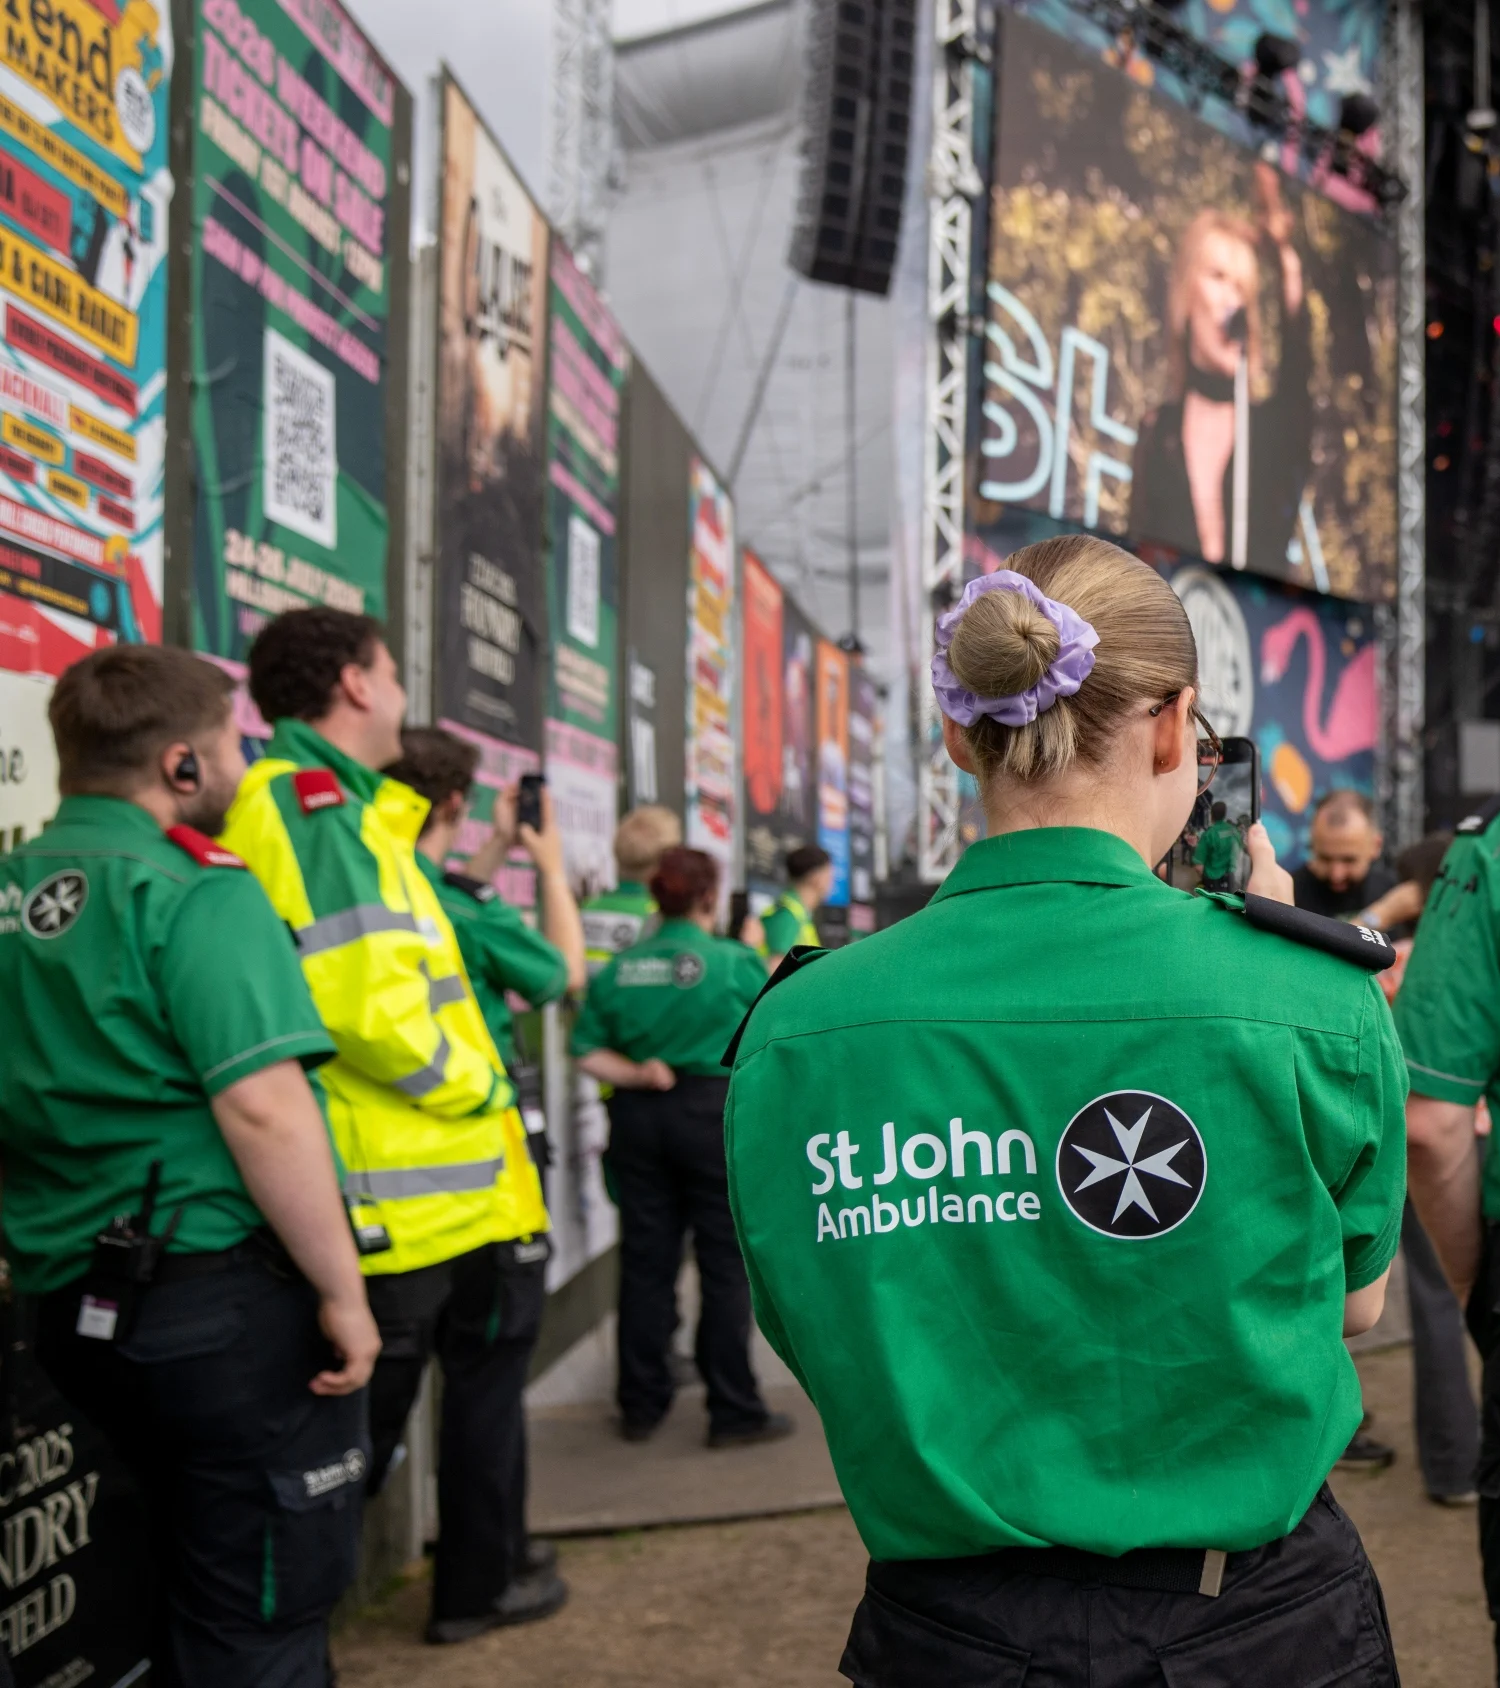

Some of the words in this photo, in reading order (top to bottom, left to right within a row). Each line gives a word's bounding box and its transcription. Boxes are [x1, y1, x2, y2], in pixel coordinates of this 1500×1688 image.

[7, 25, 114, 143] MAKERS
[806, 1130, 863, 1196] St
[873, 1117, 1038, 1187] John
[816, 1186, 1041, 1243] Ambulance
